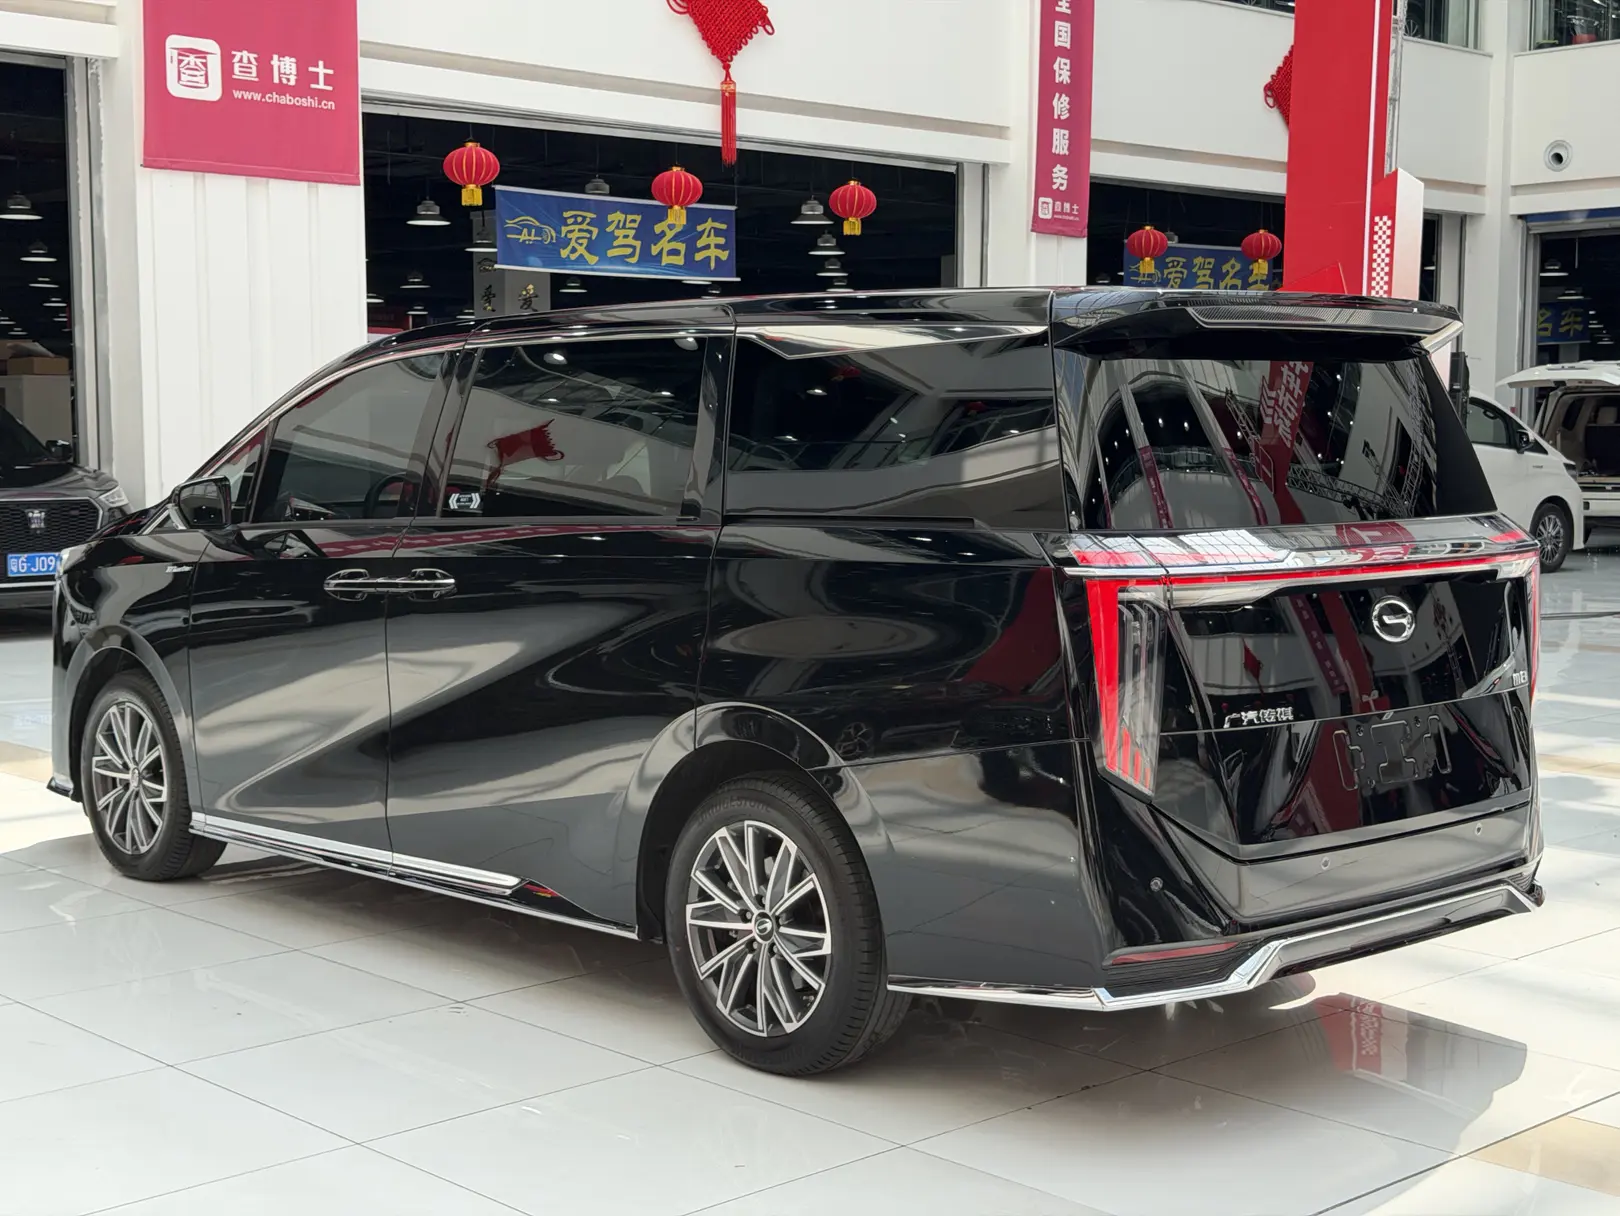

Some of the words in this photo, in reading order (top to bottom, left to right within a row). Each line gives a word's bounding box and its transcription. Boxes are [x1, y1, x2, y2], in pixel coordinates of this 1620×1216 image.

[231, 50, 335, 91] 查博士
[232, 89, 336, 110] www.chaboshi.cn
[559, 210, 730, 270] 爱驾名车
[1223, 706, 1295, 729] 广汽传祺
